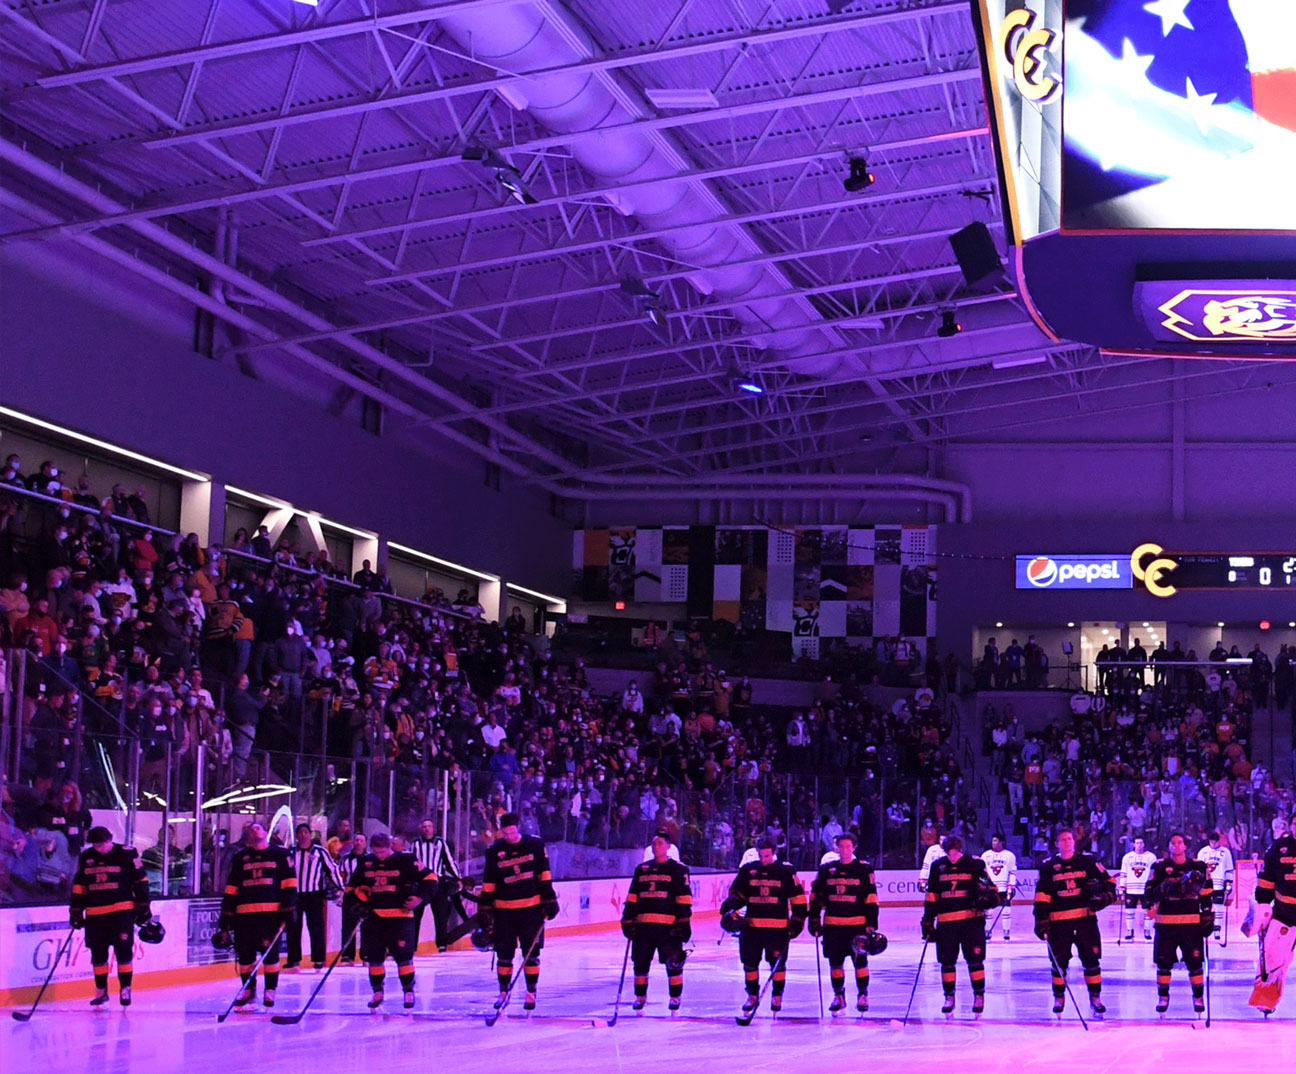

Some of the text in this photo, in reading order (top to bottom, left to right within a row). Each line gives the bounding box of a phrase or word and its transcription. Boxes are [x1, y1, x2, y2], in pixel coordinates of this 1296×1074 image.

[1059, 561, 1120, 583] pepsi
[1259, 567, 1271, 585] 0
[951, 881, 958, 890] 7
